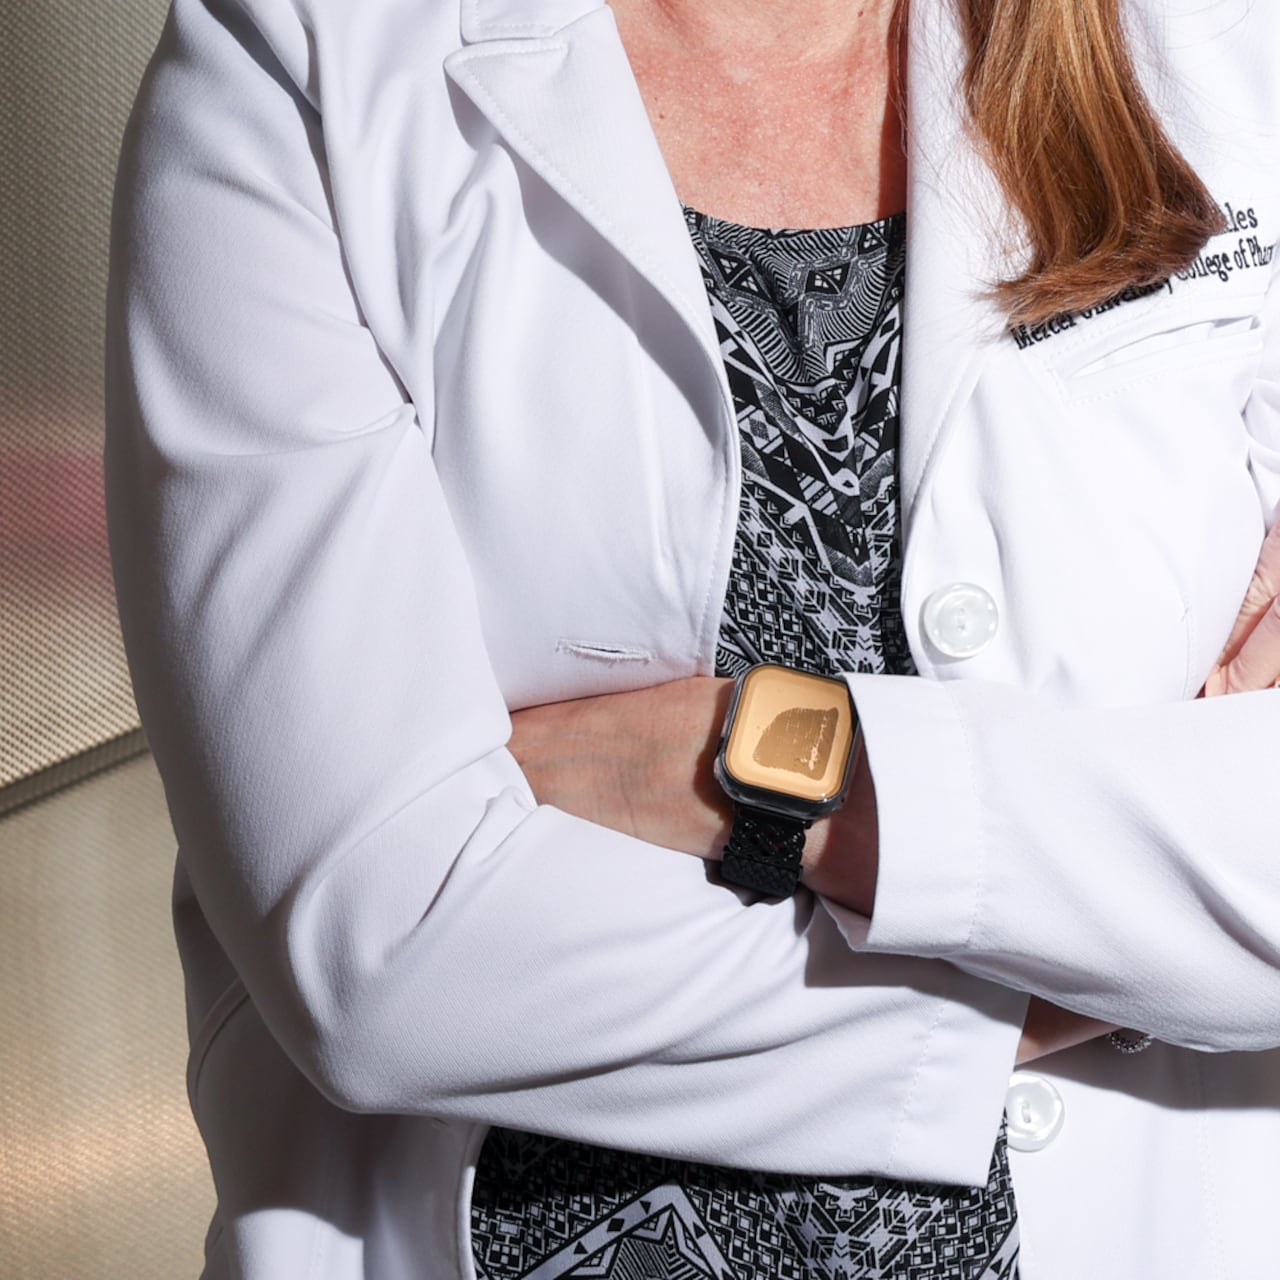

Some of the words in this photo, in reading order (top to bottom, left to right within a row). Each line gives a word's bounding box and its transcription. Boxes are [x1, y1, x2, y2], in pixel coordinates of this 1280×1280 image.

[1224, 202, 1258, 233] les
[1234, 238, 1250, 270] of
[1247, 235, 1276, 268] Phar
